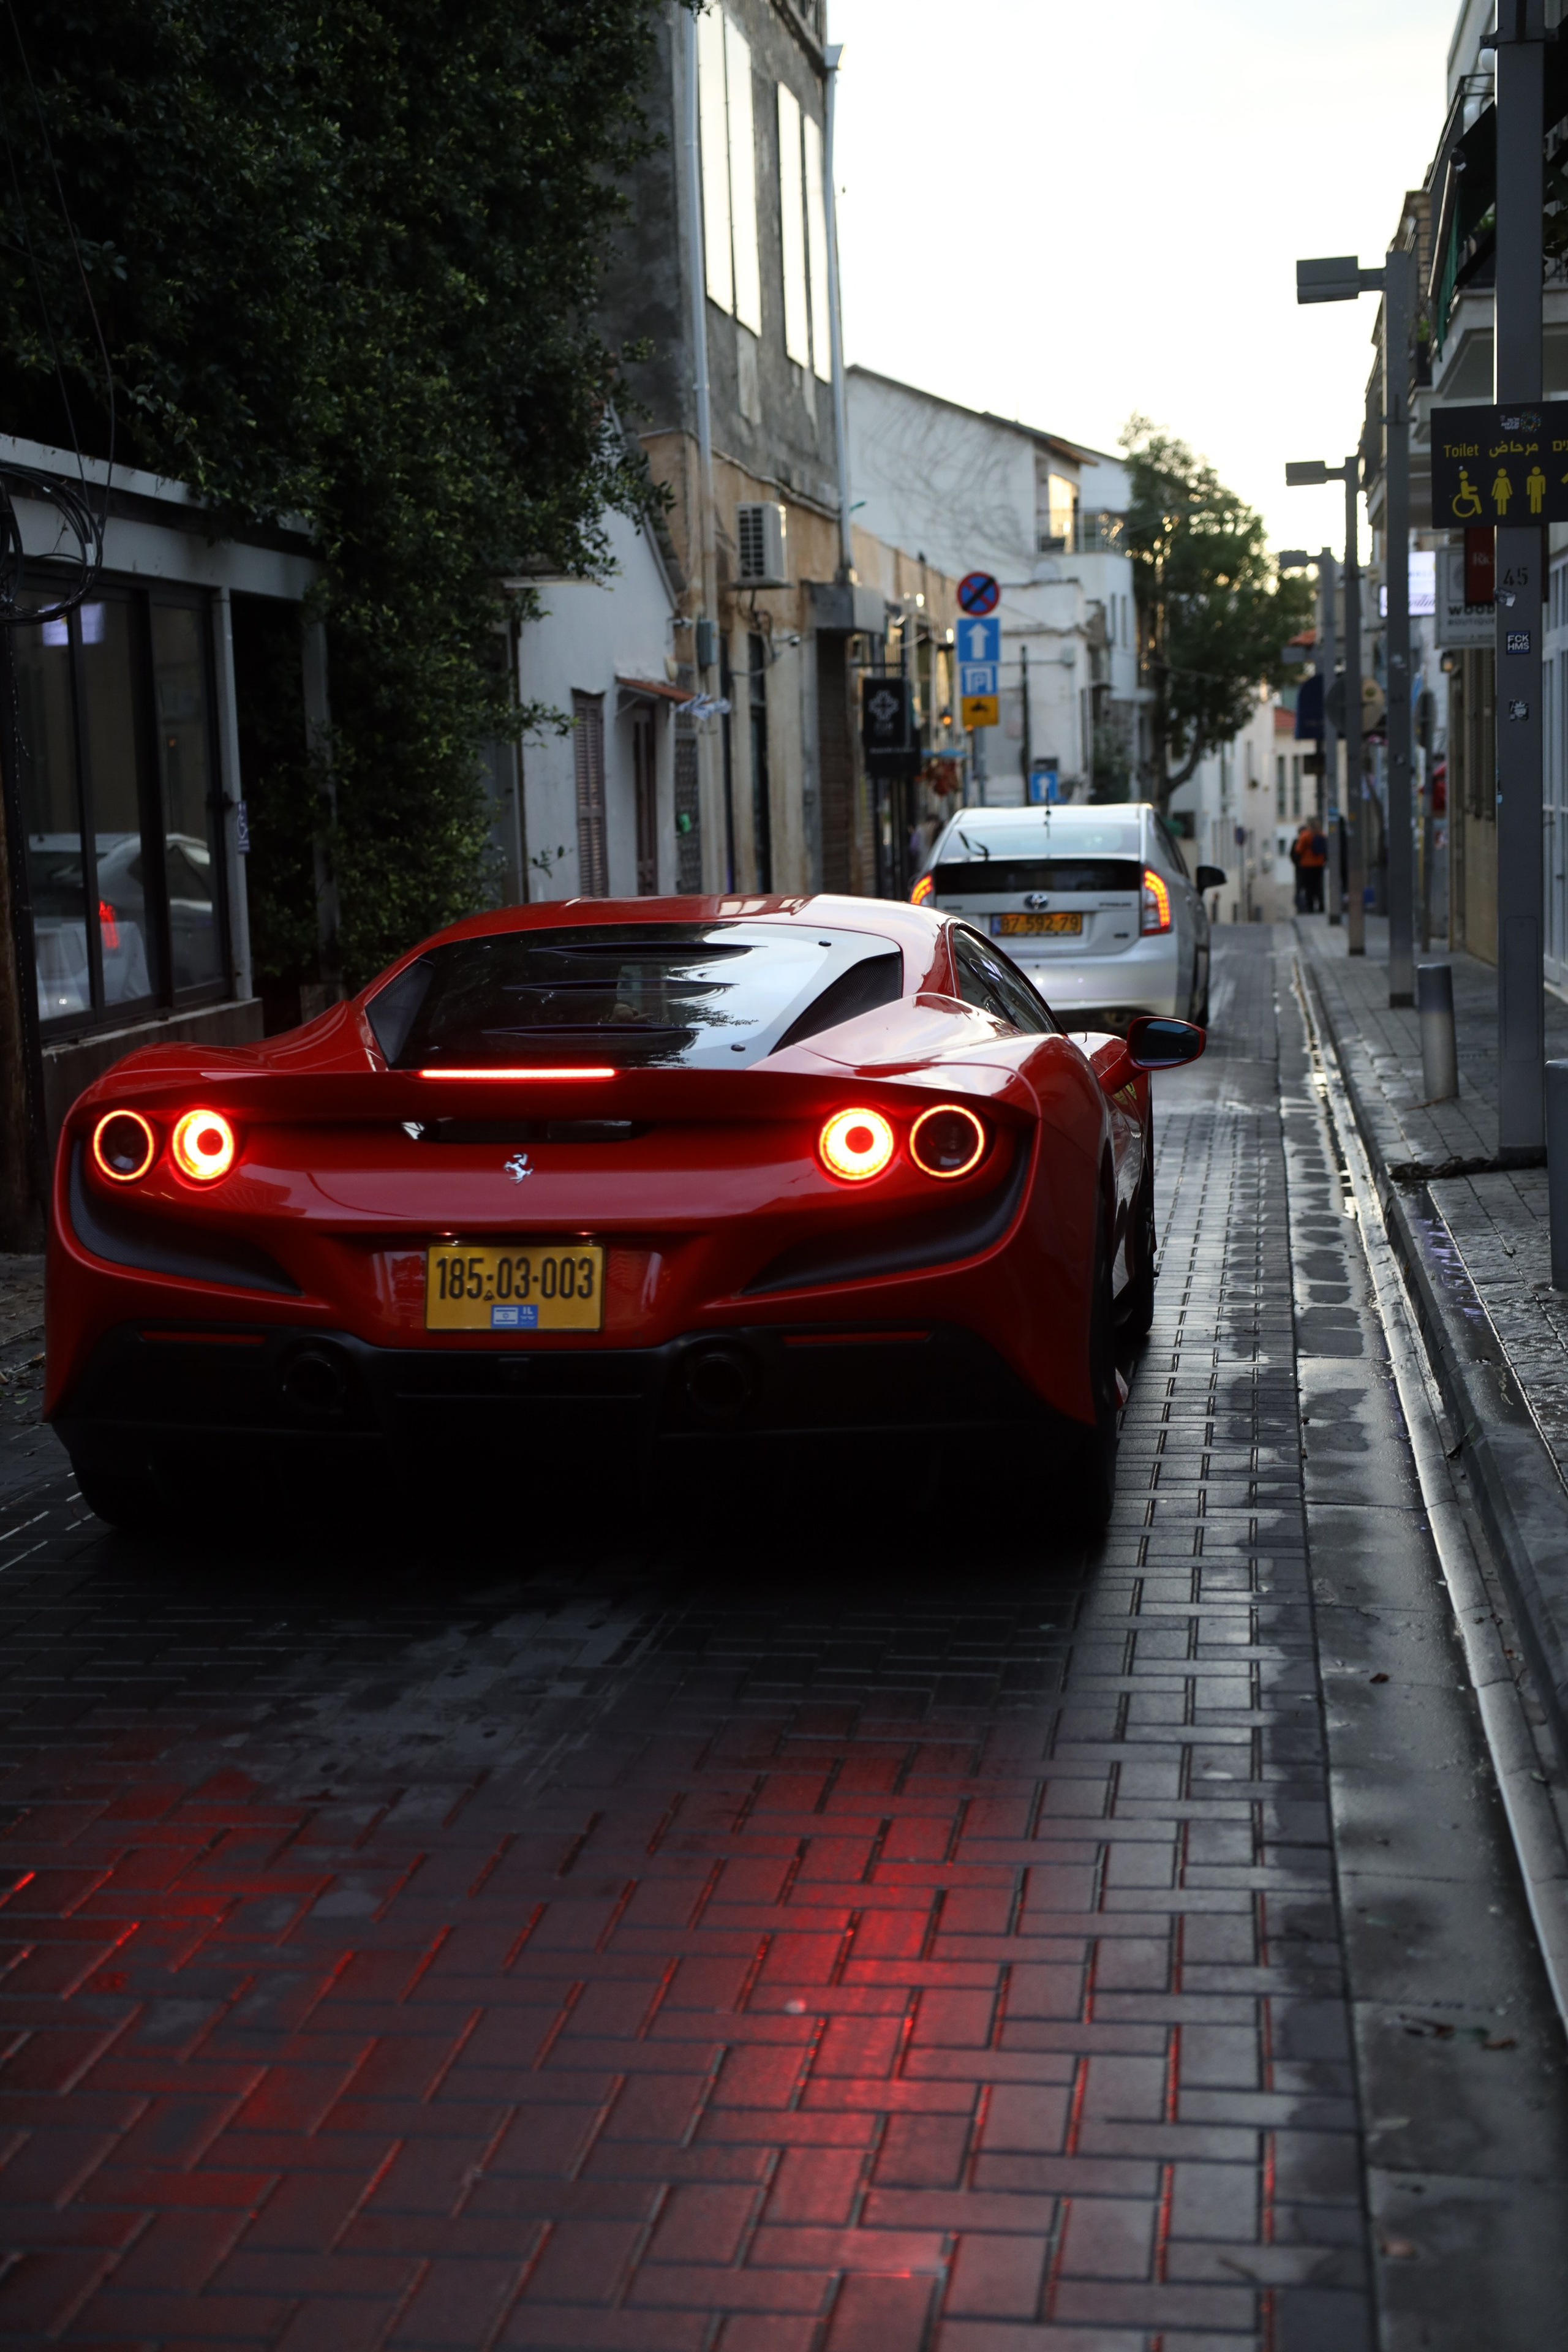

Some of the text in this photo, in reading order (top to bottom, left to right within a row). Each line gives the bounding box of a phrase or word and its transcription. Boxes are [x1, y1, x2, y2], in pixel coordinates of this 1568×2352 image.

[1444, 443, 1479, 458] Toilet
[1489, 439, 1539, 458] مرحاض
[1503, 567, 1528, 586] 45
[1507, 634, 1529, 643] FCK
[1507, 642, 1529, 650] HMS
[522, 1306, 533, 1315] IL
